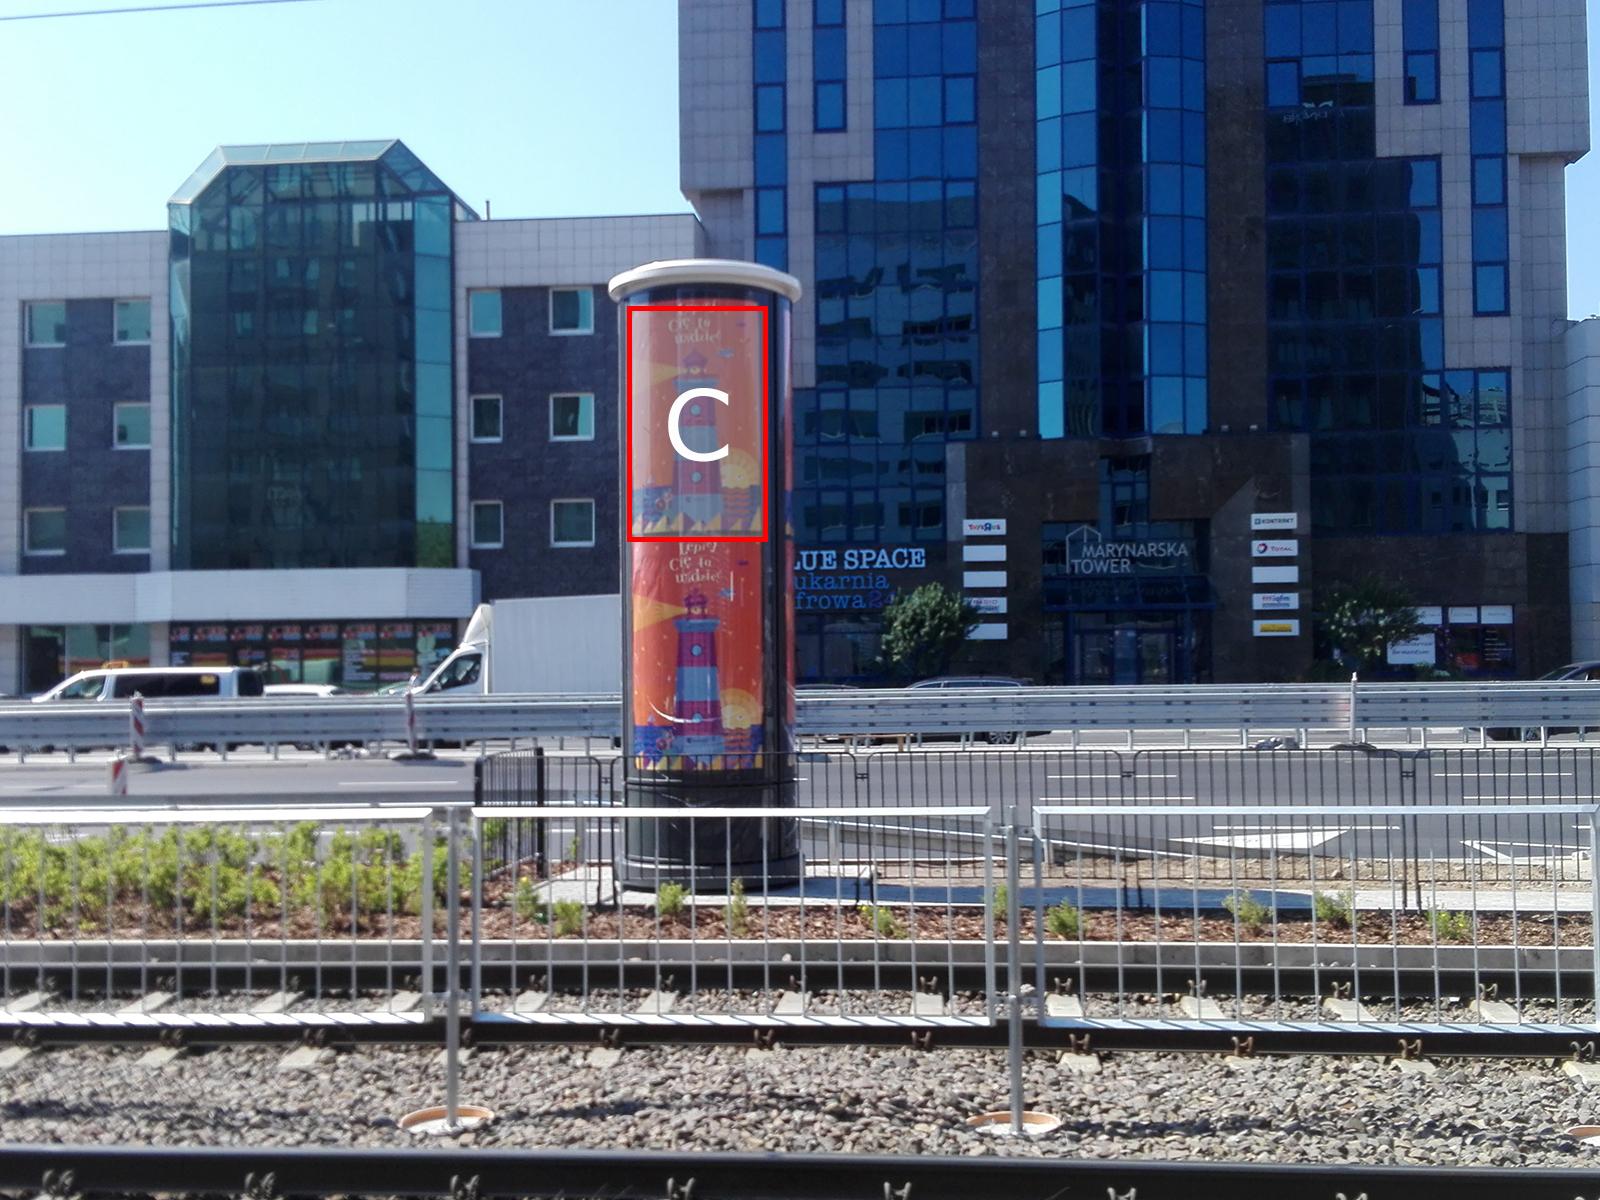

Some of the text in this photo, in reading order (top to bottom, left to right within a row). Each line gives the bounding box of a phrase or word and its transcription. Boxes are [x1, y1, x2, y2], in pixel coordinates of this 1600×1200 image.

[1082, 542, 1189, 558] MARYNARSKA
[793, 548, 926, 570] UE SPACE
[1071, 559, 1131, 575] TOWER
